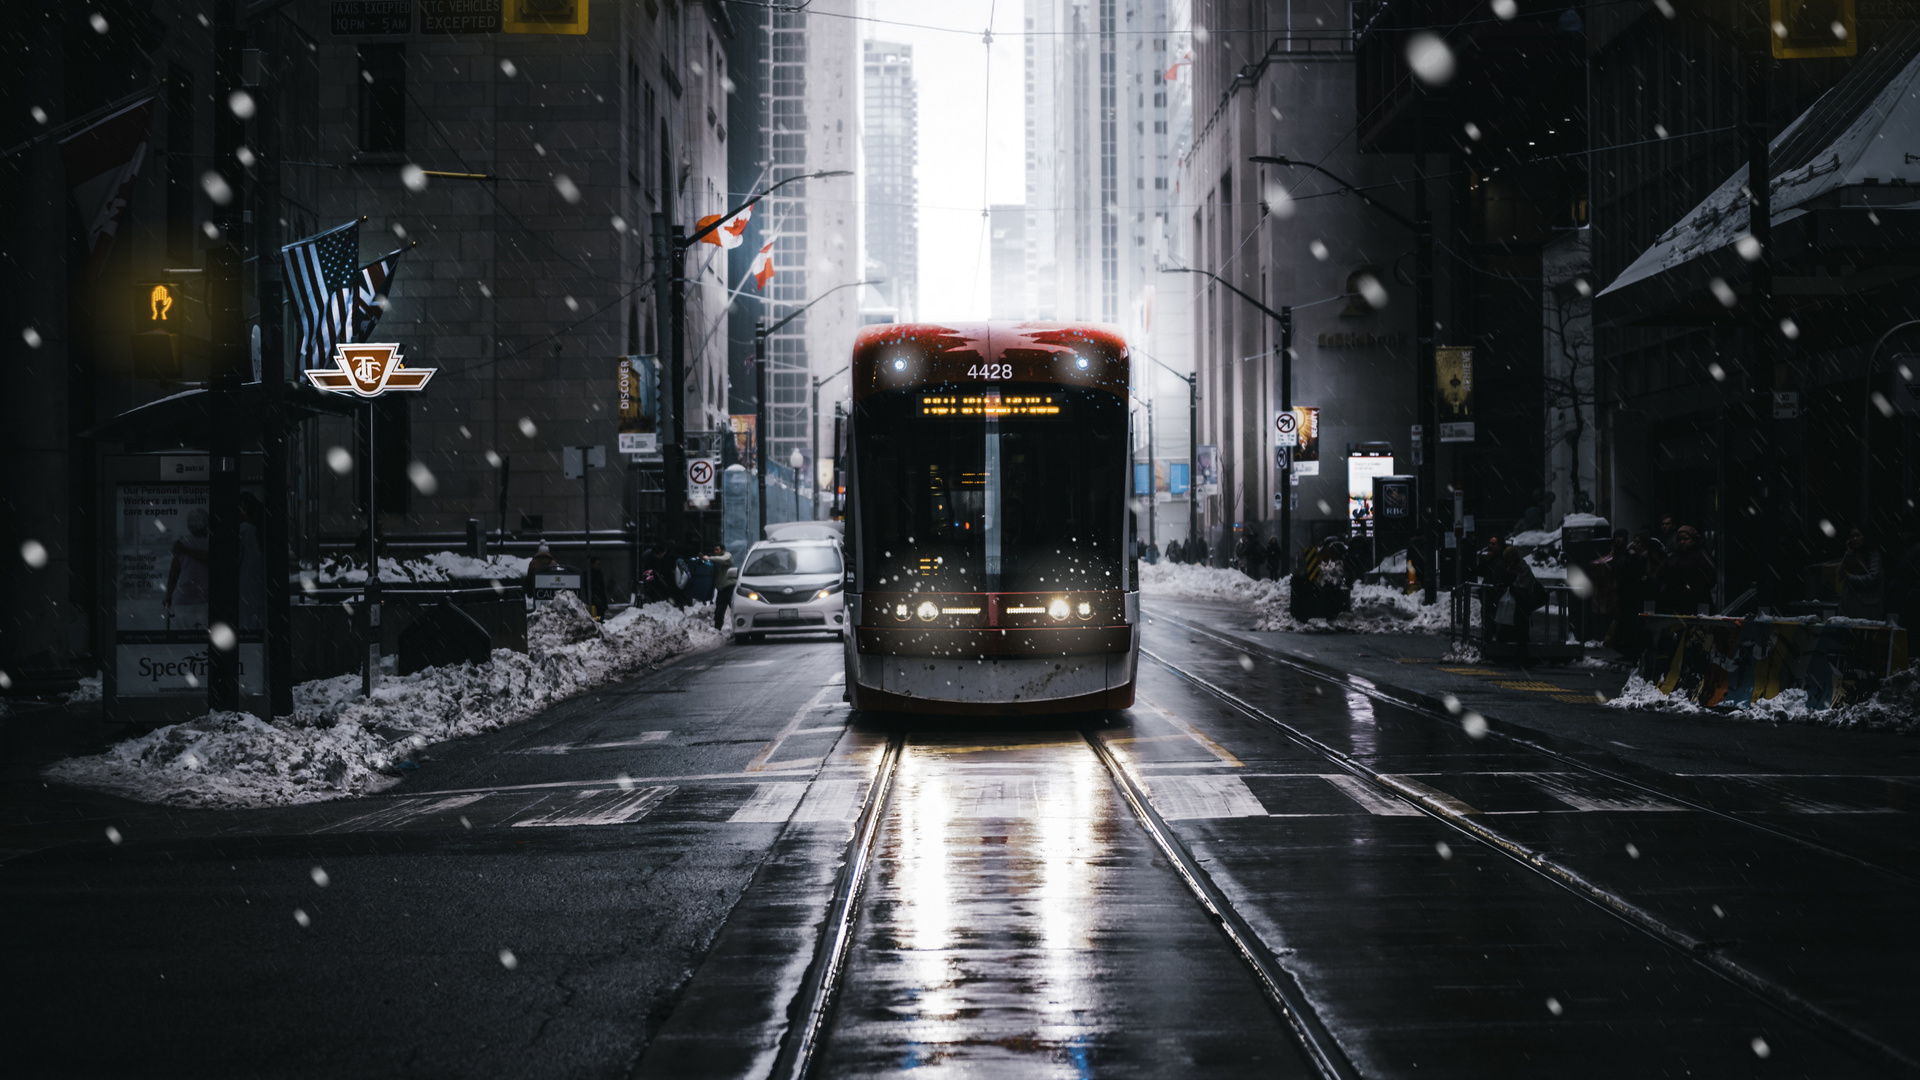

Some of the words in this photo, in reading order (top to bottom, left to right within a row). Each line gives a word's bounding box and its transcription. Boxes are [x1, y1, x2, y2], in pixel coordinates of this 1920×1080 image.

[332, 1, 359, 15] TAXIS
[364, 1, 411, 14] EXCEPTED
[423, 0, 444, 13] TTC
[450, 0, 500, 13] VEHICLES
[426, 16, 496, 30] EXCEPTED
[967, 363, 1013, 379] 4428
[1461, 350, 1473, 392] ACHIEVE
[620, 360, 630, 410] DISCOVER
[1310, 410, 1320, 438] BEAUTY
[123, 486, 139, 495] Our
[141, 486, 180, 495] Personal
[123, 496, 161, 505] Workers
[178, 496, 207, 505] health
[123, 508, 143, 516] care
[144, 507, 178, 517] experts
